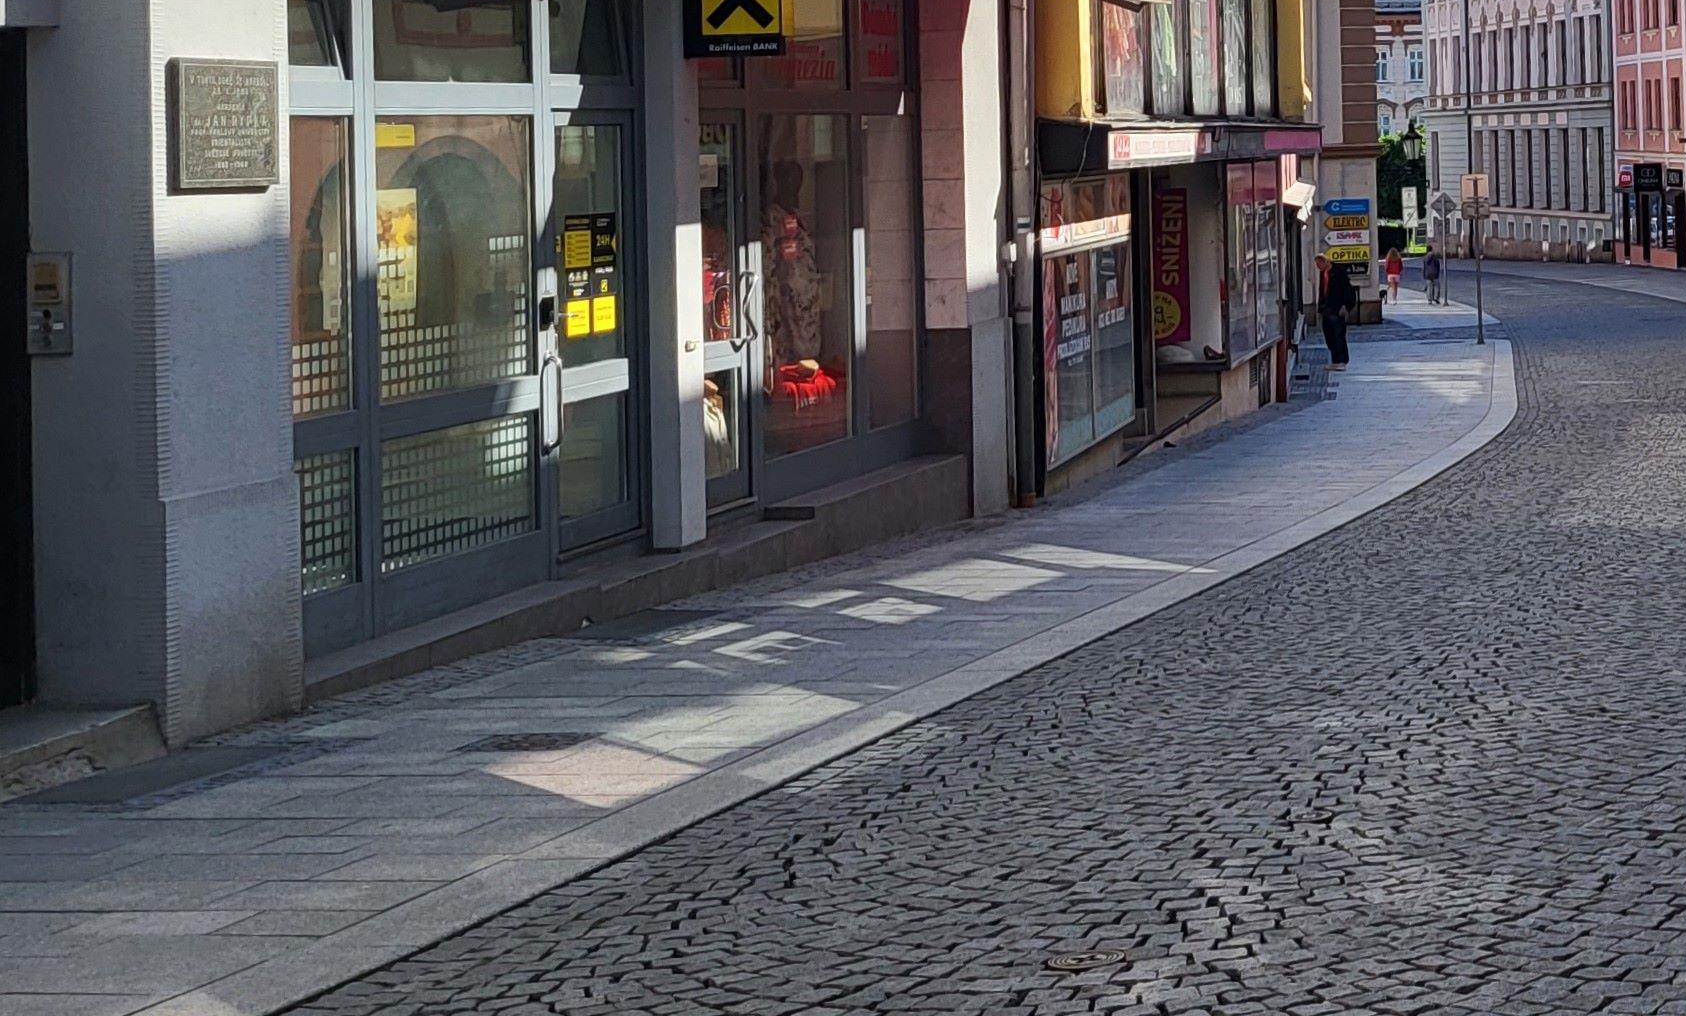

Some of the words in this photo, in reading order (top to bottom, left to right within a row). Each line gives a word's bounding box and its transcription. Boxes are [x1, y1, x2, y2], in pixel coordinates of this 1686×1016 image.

[709, 43, 751, 52] Raiffeisen
[1155, 195, 1184, 286] SNÍŽENÍ
[1331, 250, 1368, 260] OPTIKA
